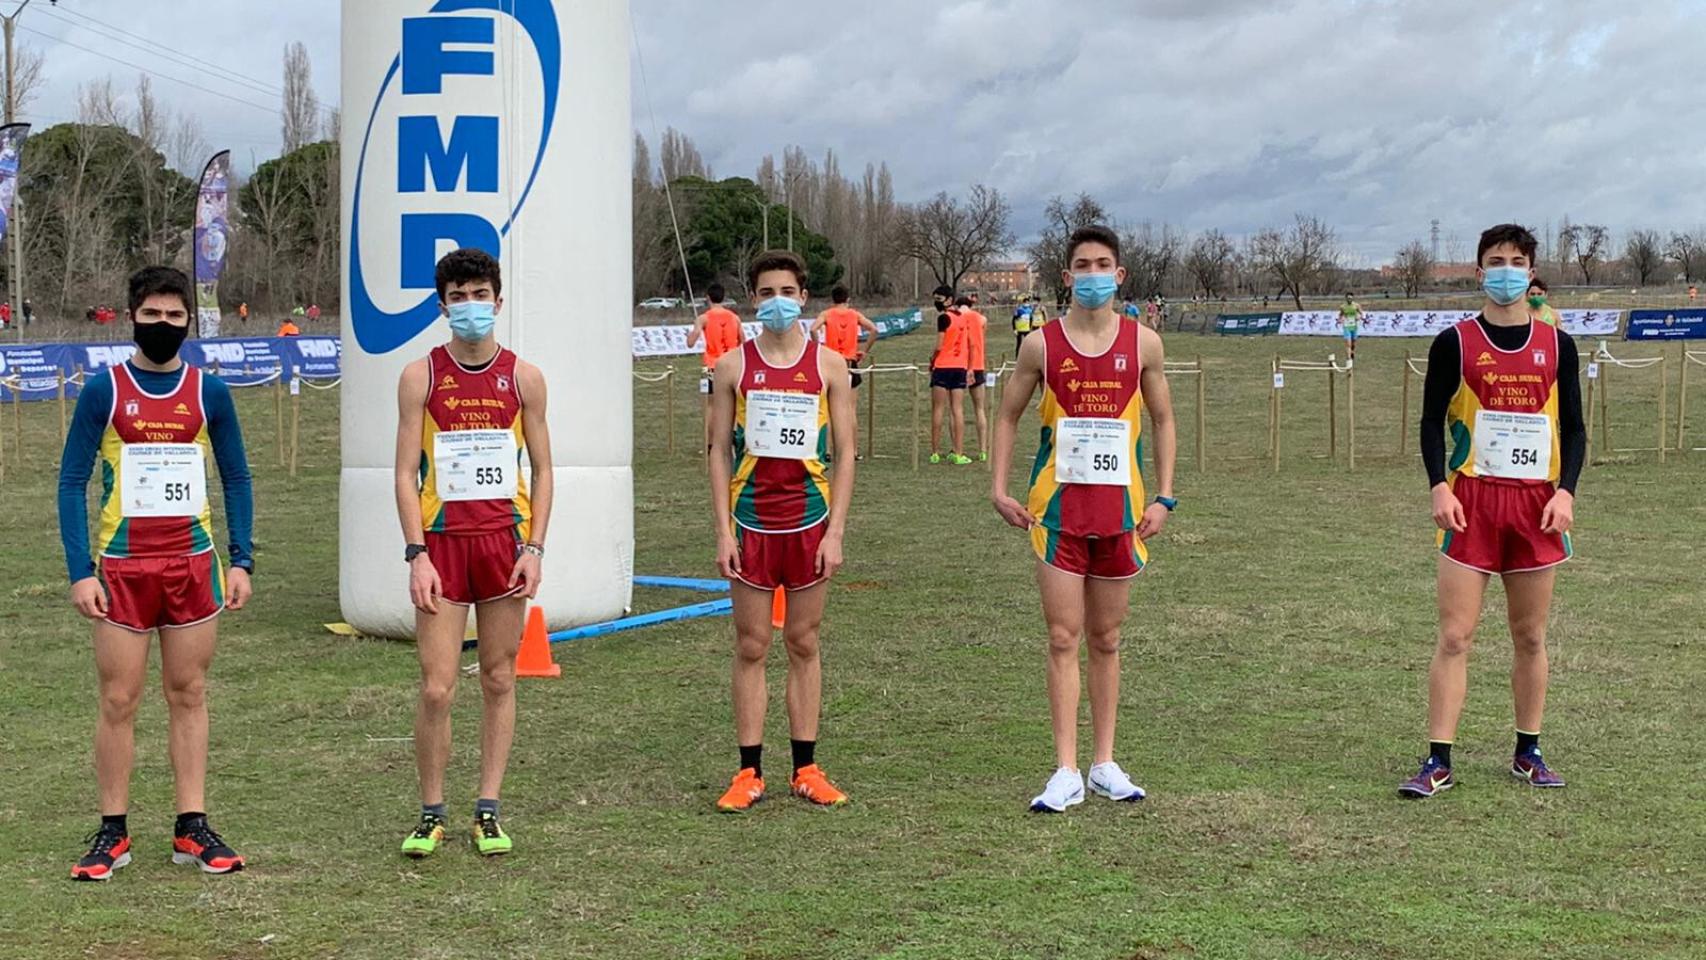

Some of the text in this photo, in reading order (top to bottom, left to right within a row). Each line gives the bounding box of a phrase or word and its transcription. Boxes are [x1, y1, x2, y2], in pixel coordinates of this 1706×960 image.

[1498, 387, 1528, 396] VINO
[1080, 394, 1108, 402] VINO
[1490, 396, 1537, 406] DE TORO
[1086, 404, 1117, 412] TORO
[460, 412, 490, 421] VINO
[145, 432, 174, 440] VINO
[780, 428, 805, 446] 552
[1512, 448, 1537, 466] 554
[1094, 454, 1118, 471] 550
[476, 467, 502, 485] 553
[165, 483, 190, 501] 551
